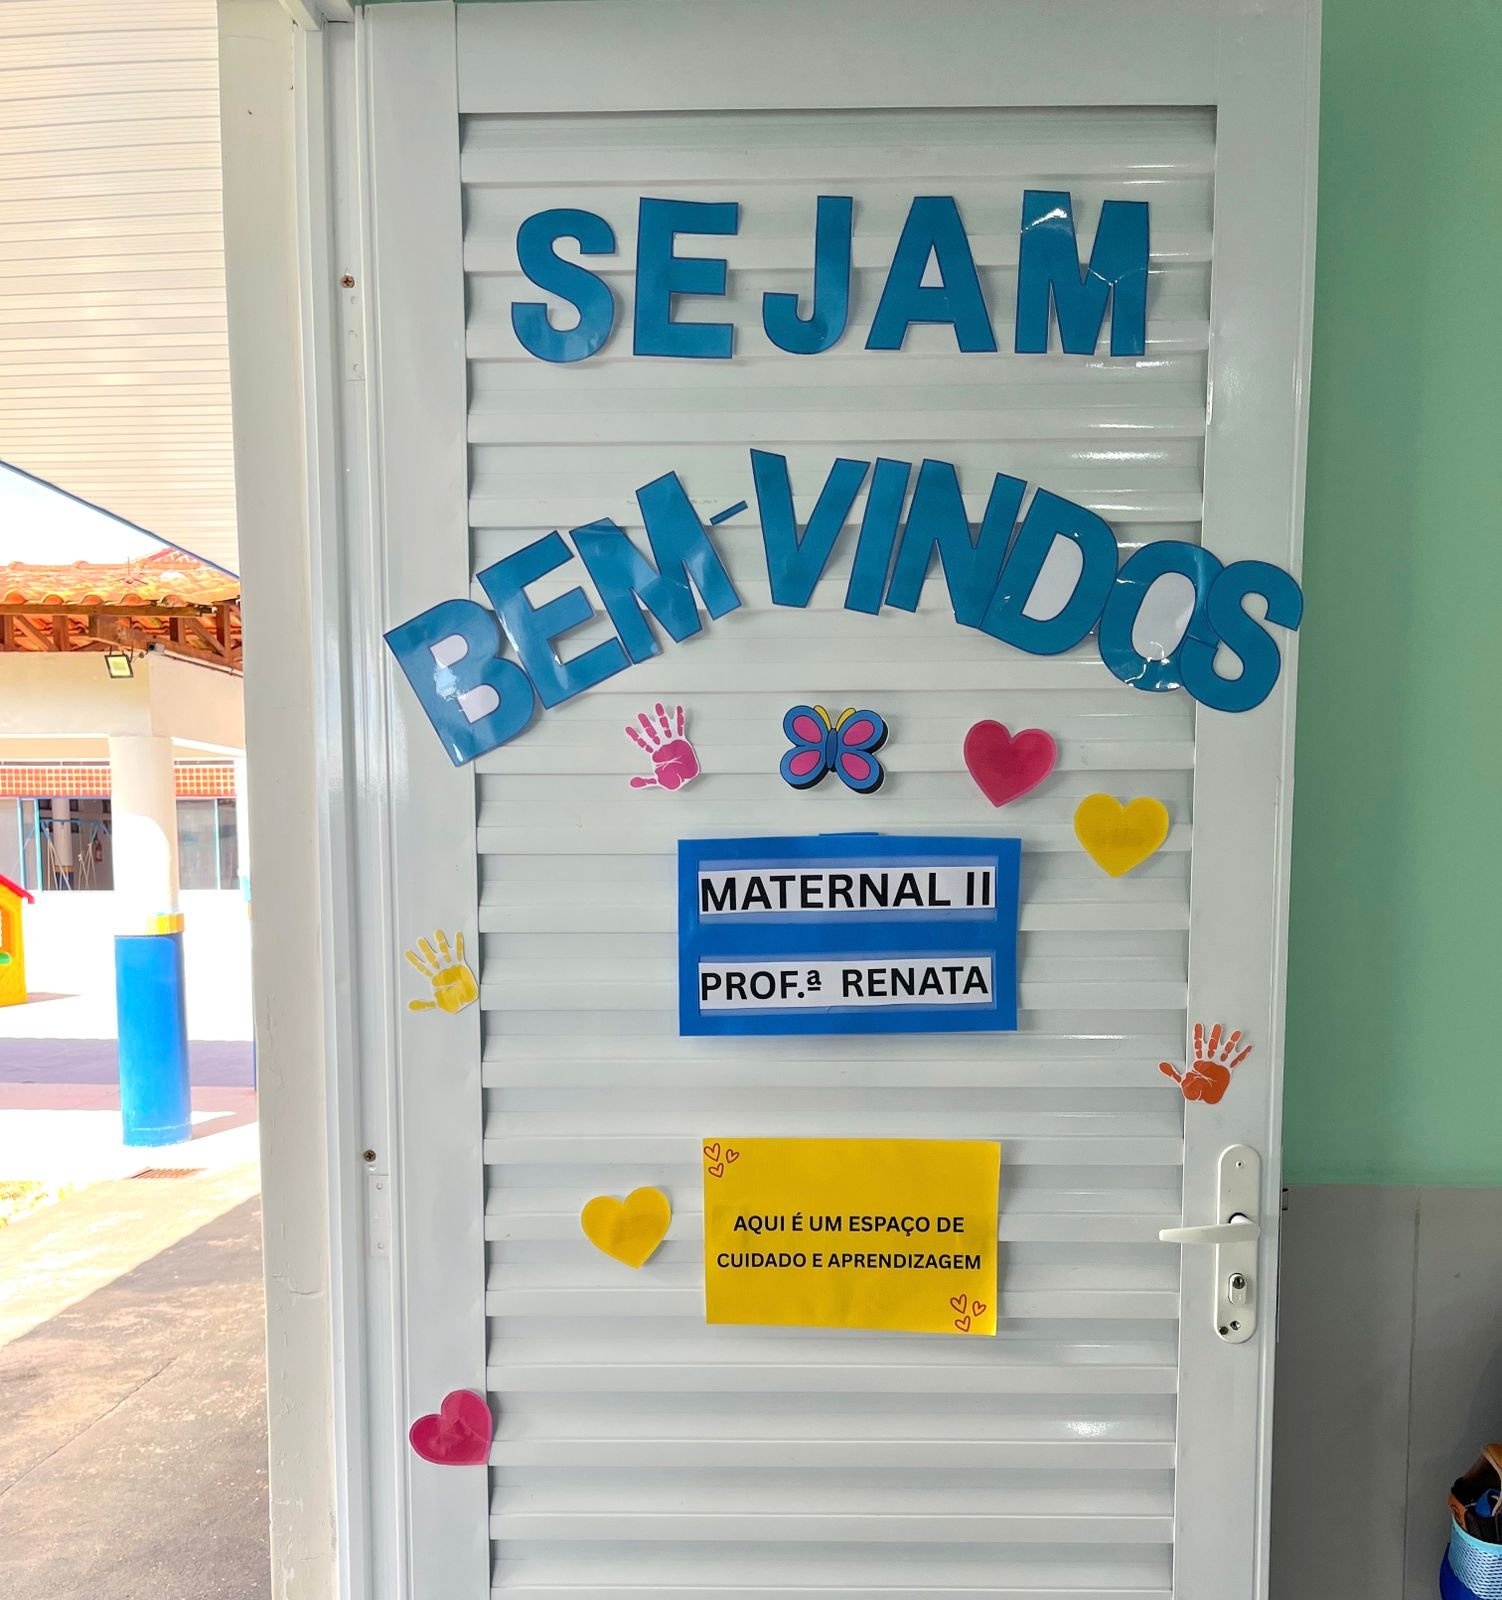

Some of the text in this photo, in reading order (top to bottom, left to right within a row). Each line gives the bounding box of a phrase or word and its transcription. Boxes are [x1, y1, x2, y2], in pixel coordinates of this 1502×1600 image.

[511, 190, 1150, 363] SEJAM
[384, 448, 1304, 765] BEM-VINDOS
[701, 871, 991, 912] MATERNAL II
[701, 965, 989, 1001] PROF.ª RENATA
[733, 1212, 965, 1237] AQUI É UM ESPAÇO DE
[717, 1253, 982, 1270] CUIDADO E APRENDIZAGEM
